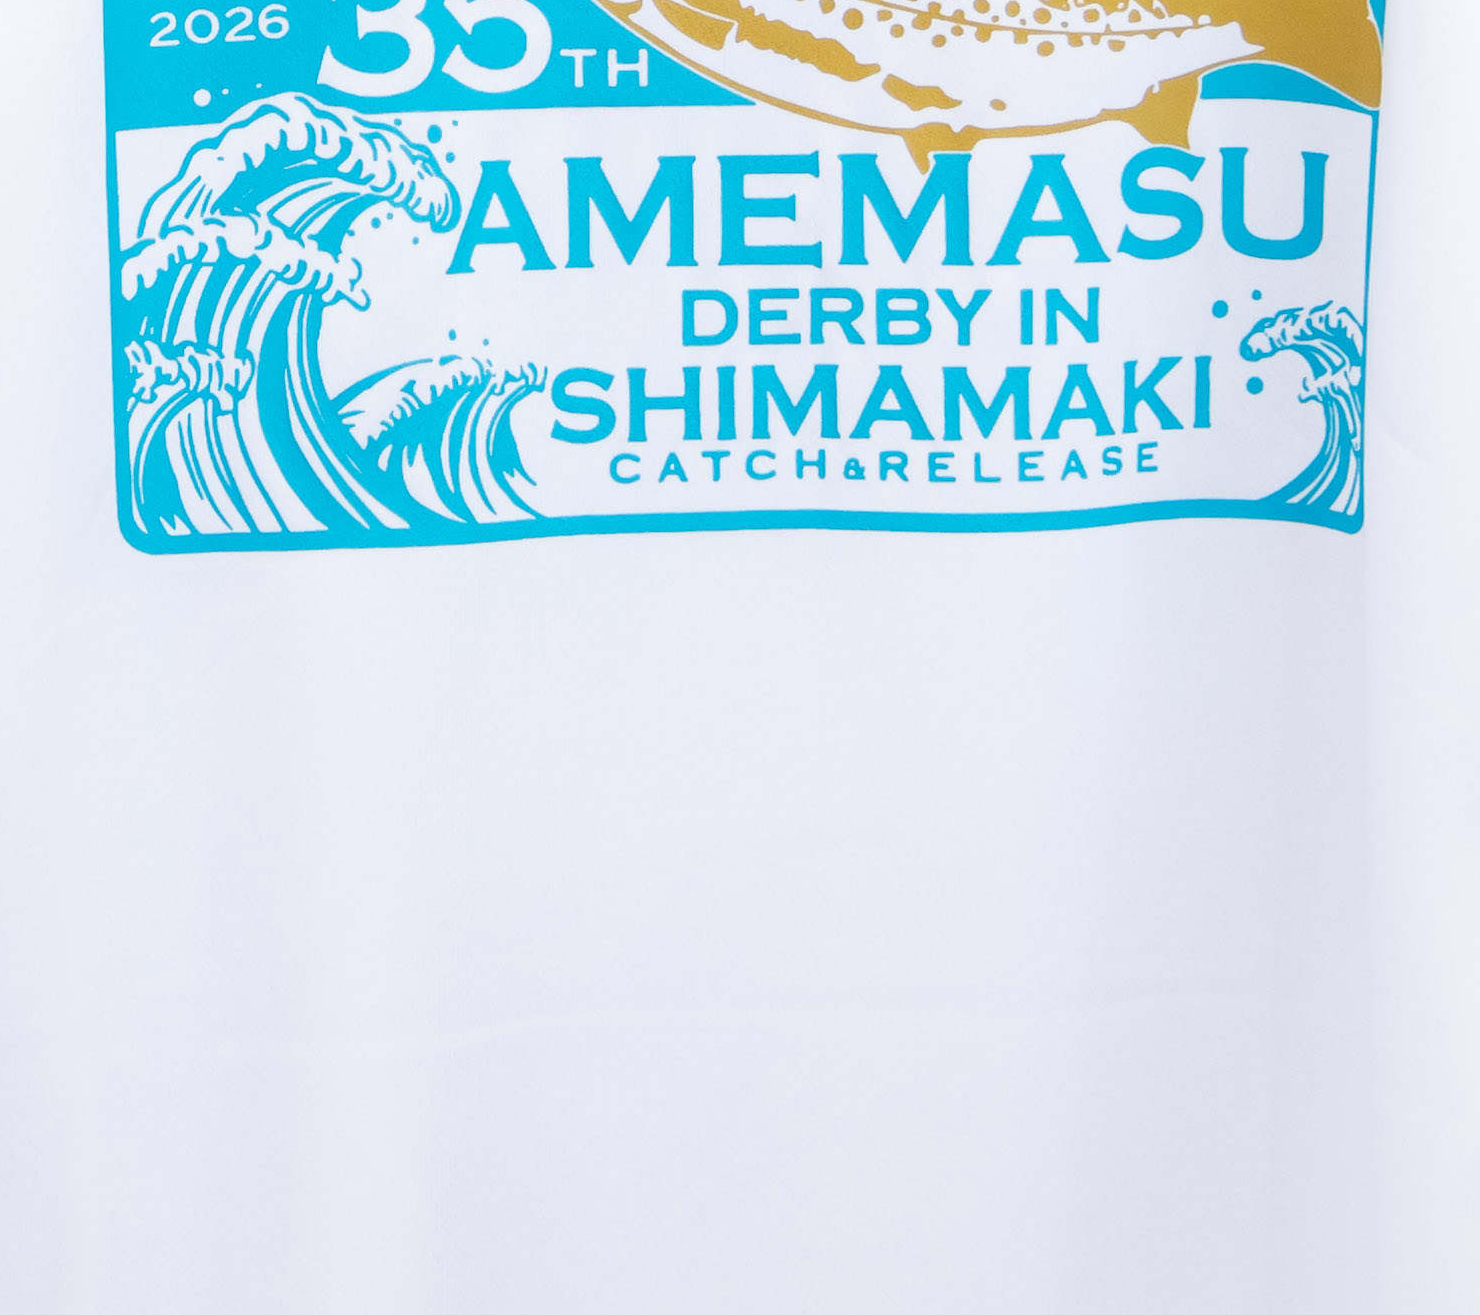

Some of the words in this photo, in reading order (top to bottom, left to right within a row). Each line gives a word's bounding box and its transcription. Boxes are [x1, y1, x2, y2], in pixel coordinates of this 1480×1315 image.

[148, 2, 291, 48] 2026
[445, 146, 1330, 275] AMEMASU
[681, 286, 993, 347] DERBY
[1020, 286, 1101, 346] IN
[550, 354, 1213, 446] SHIMAMAKI
